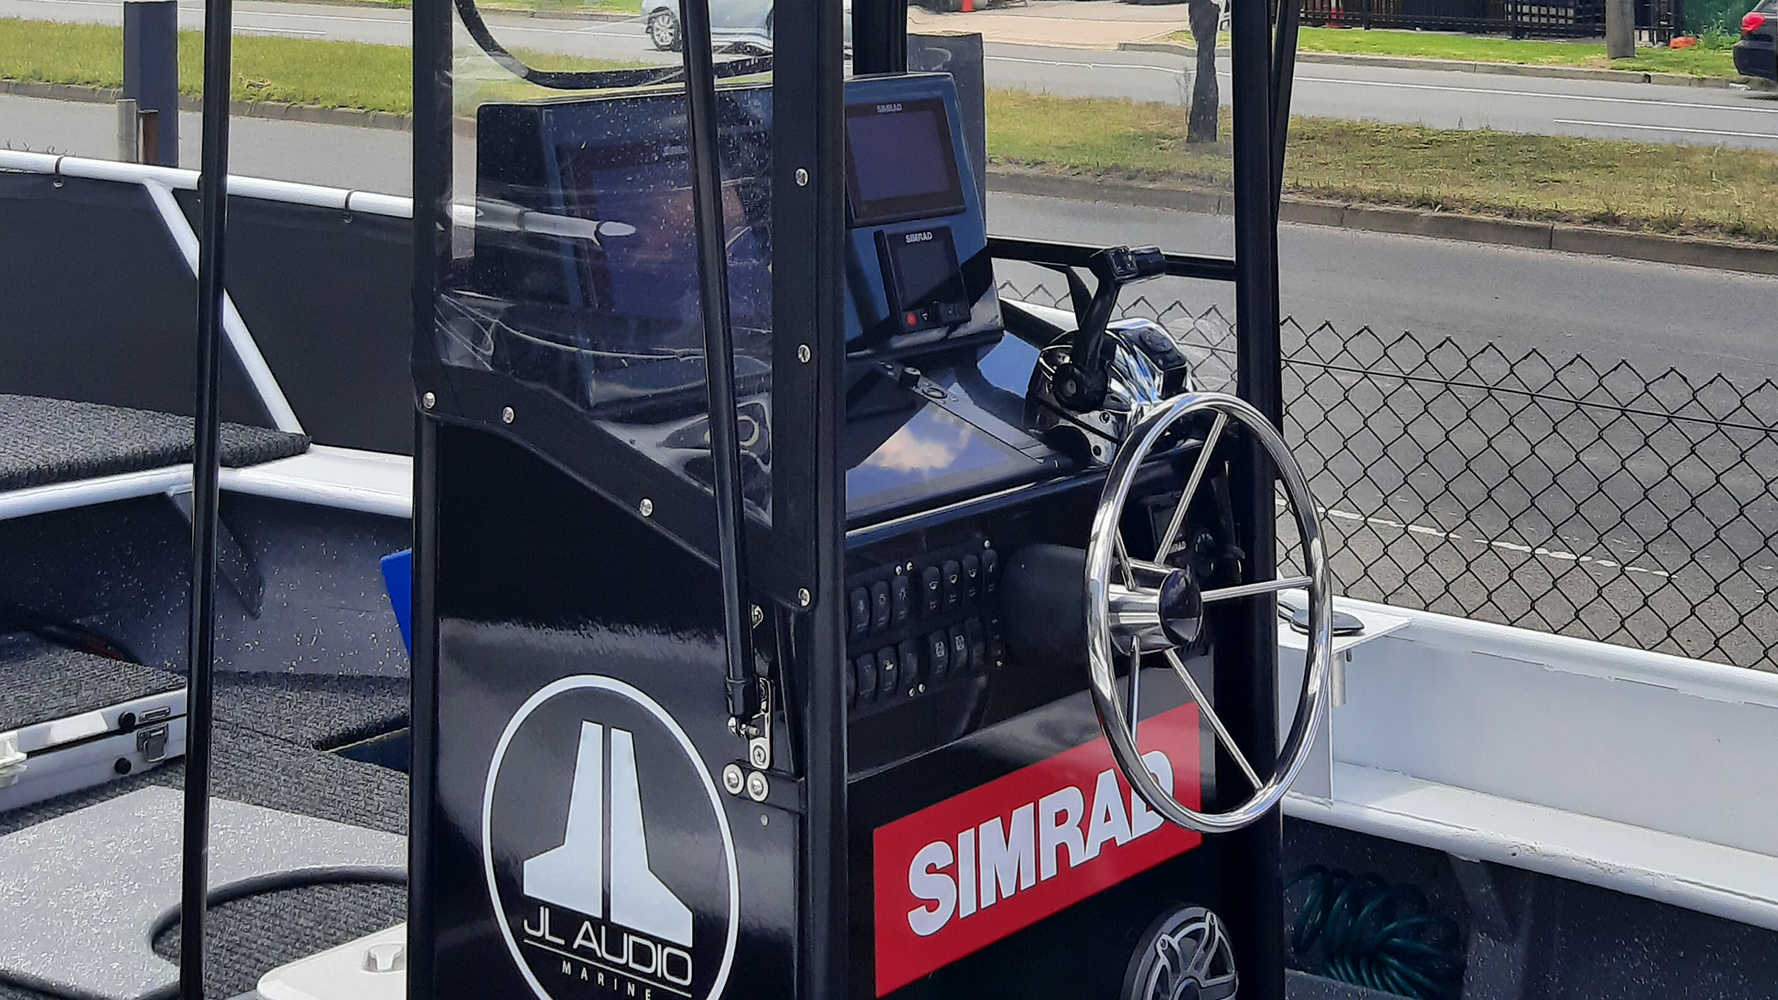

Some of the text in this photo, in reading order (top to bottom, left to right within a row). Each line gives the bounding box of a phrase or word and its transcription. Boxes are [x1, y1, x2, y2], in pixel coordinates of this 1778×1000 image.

[905, 231, 933, 243] SIMRAD
[907, 750, 1174, 937] SIMRAD
[523, 906, 693, 987] JL AUDIO
[562, 959, 653, 1000] MARINE
